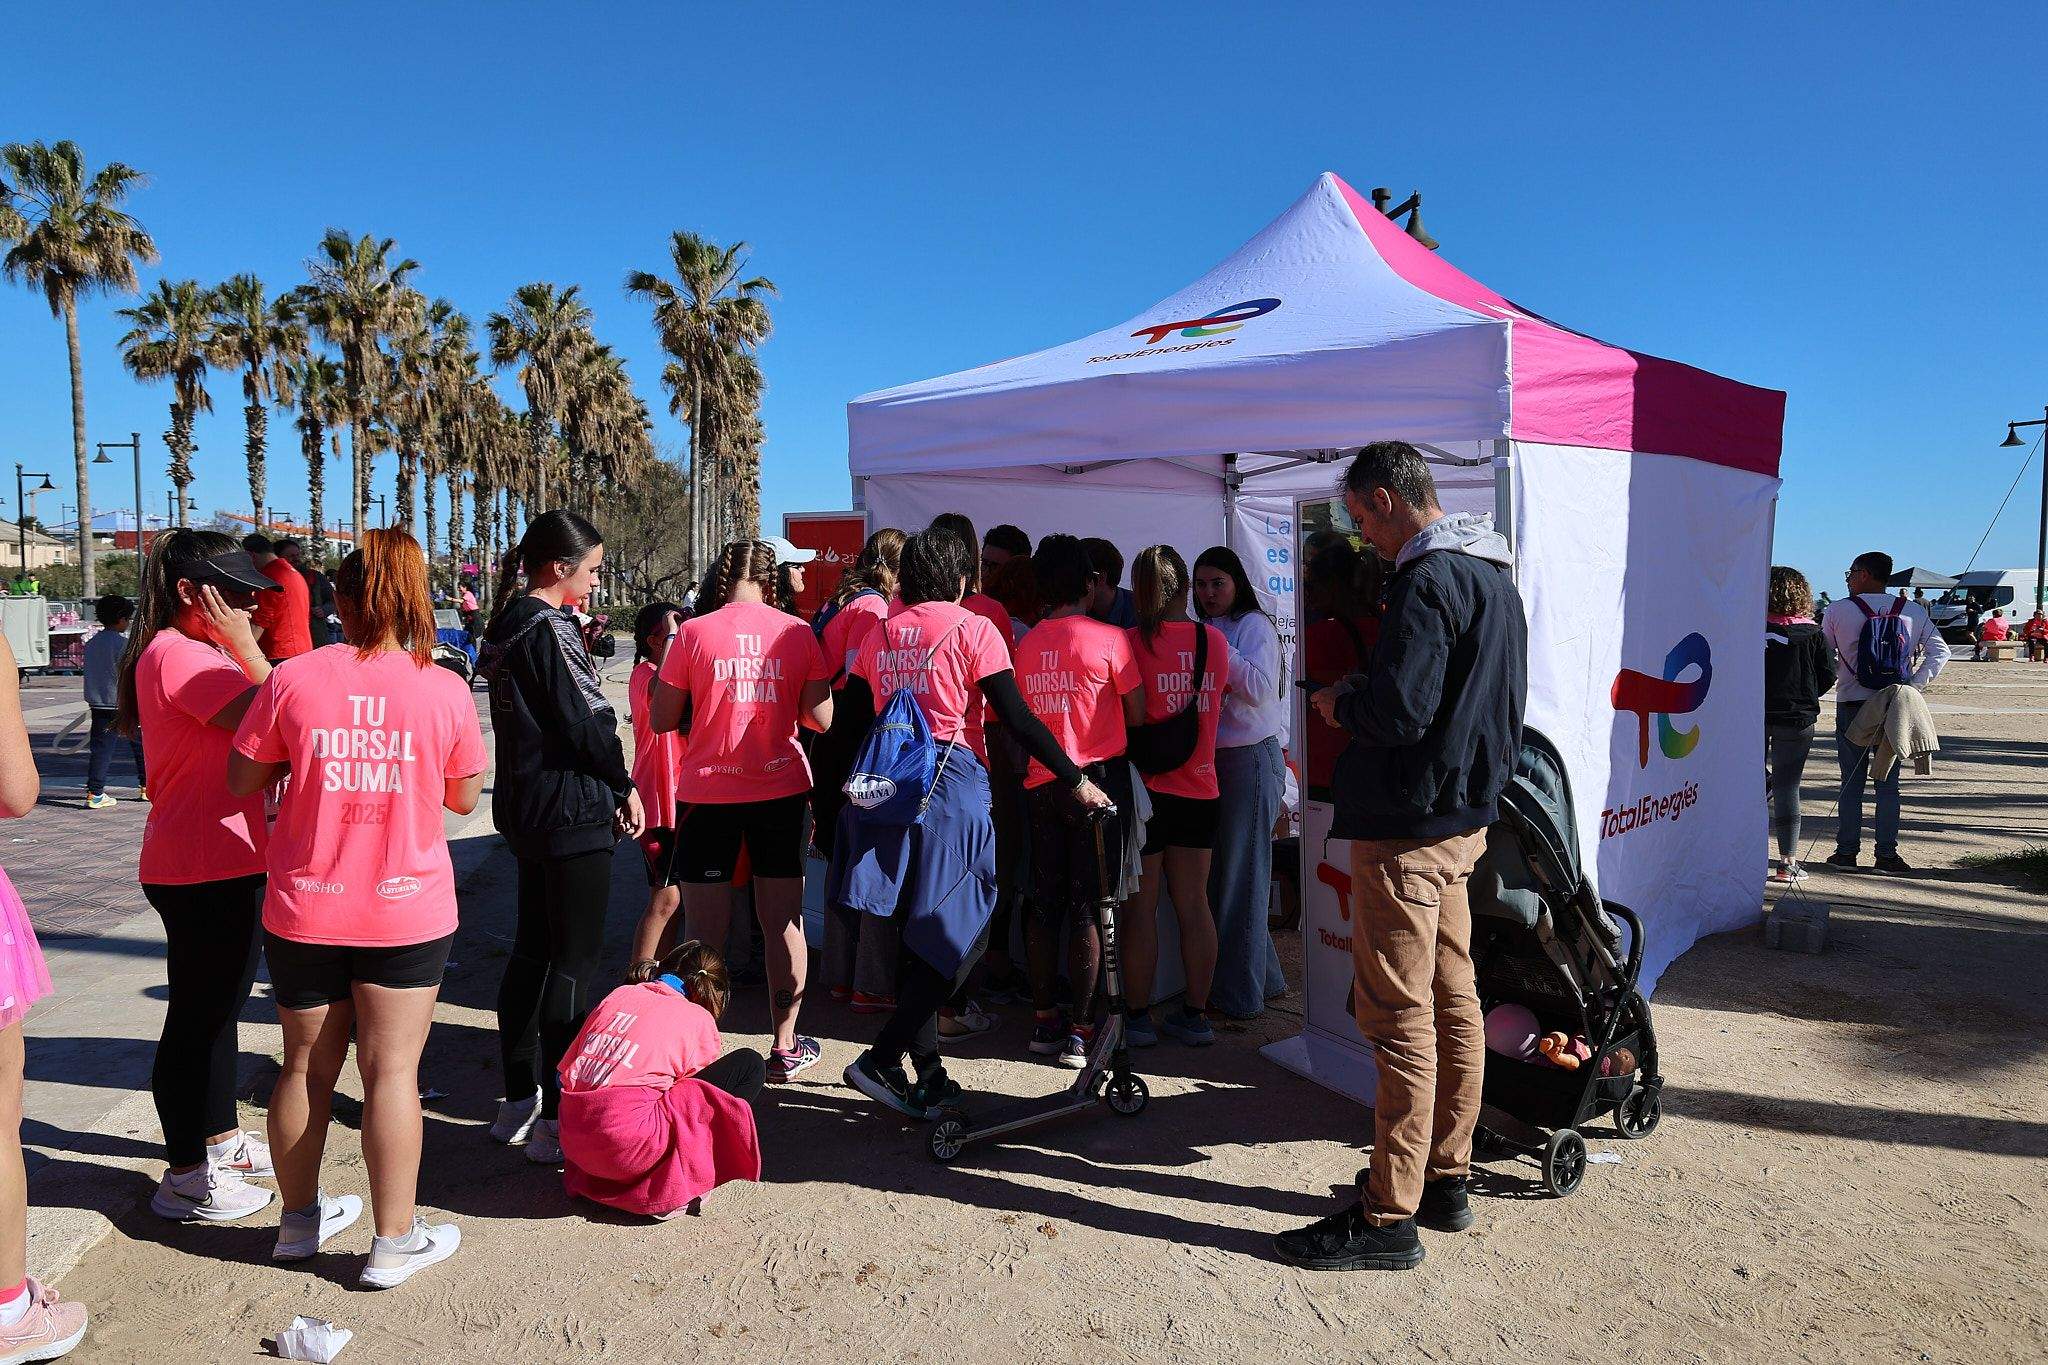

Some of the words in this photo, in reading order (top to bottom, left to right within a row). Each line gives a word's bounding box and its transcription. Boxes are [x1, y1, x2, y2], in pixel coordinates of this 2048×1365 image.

[1086, 338, 1236, 364] TotalEnergies
[1267, 516, 1290, 535] La
[1266, 548, 1289, 563] es
[736, 633, 762, 656] TU
[899, 626, 922, 647] TU
[713, 657, 784, 681] DORSAL
[1040, 650, 1059, 670] TU
[726, 680, 778, 703] SUMA
[1025, 670, 1078, 695] DORSAL
[1157, 672, 1216, 693] DORAL
[347, 694, 387, 727] TU
[1033, 693, 1072, 714] SUMA
[311, 727, 416, 761] DORSAL
[324, 761, 403, 794] SUMA
[340, 802, 387, 825] 2025
[1600, 781, 1699, 840] TotalEnergies
[294, 879, 344, 894] OYSHO
[608, 1011, 638, 1035] TU
